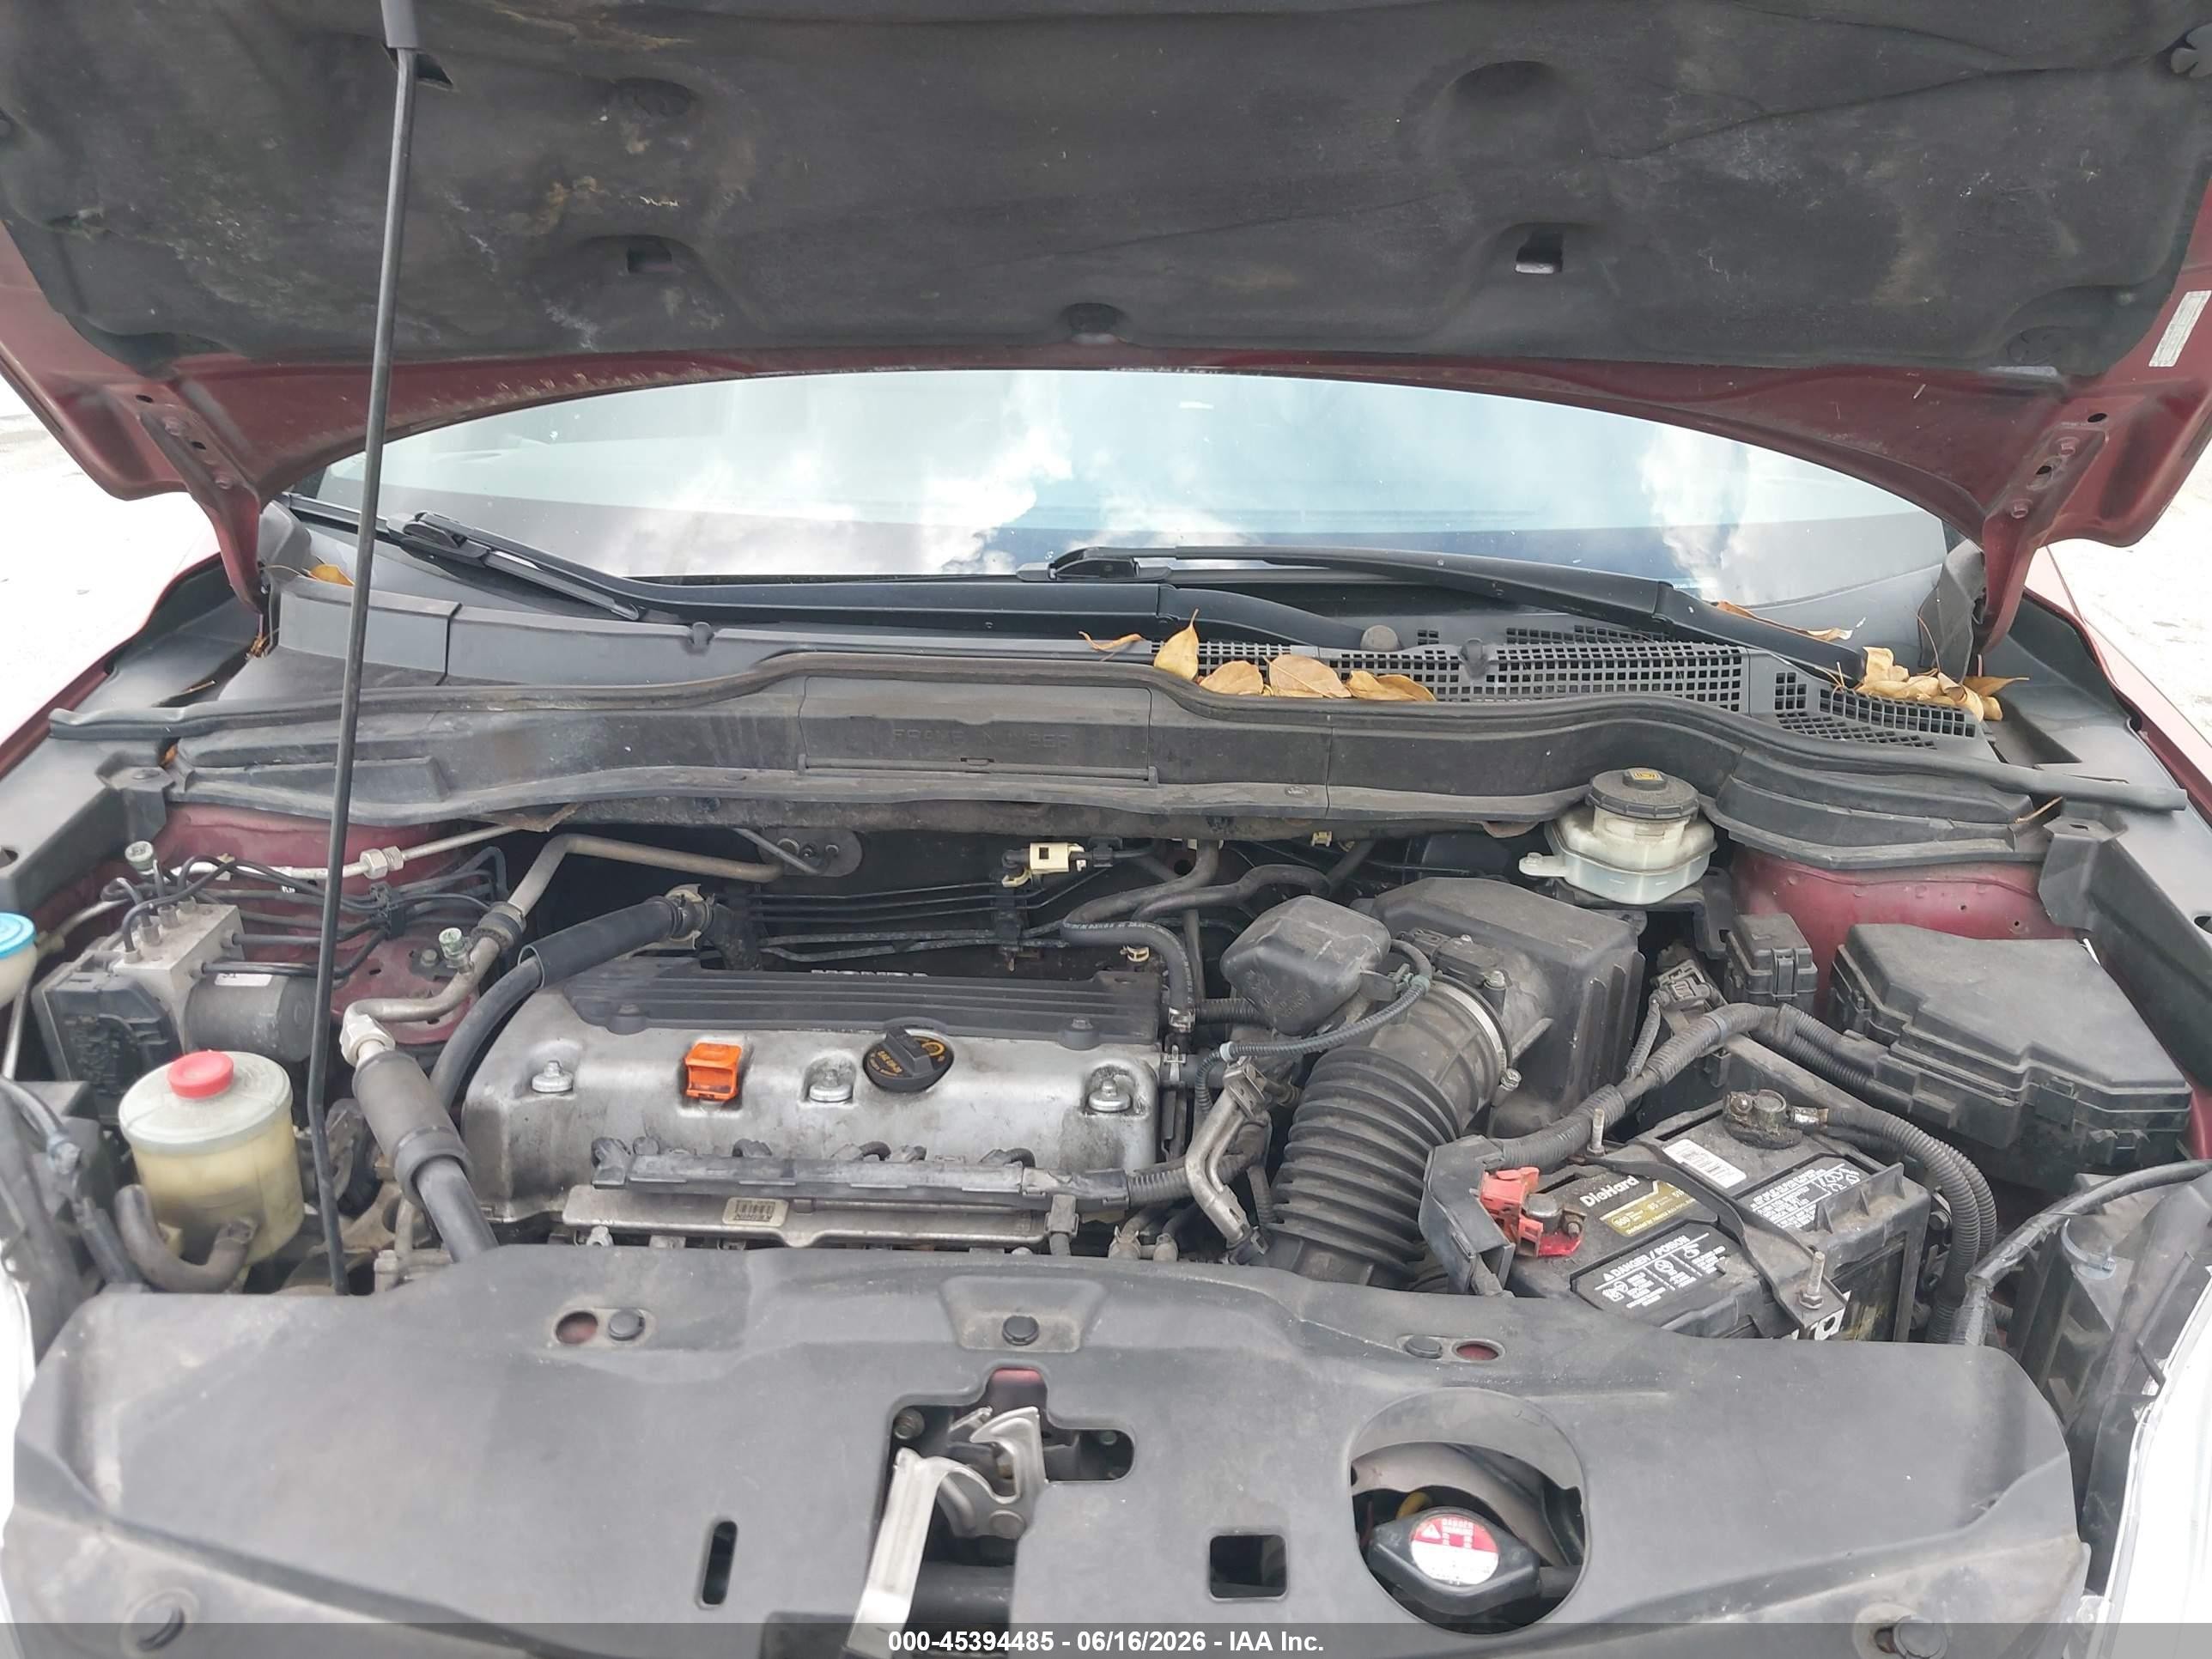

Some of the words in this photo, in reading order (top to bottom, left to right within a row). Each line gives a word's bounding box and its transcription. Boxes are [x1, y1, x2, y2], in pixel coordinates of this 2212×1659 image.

[982, 730, 1073, 748] NBER
[1580, 1175, 1640, 1207] DieHard
[1610, 1254, 1650, 1278] DANGER
